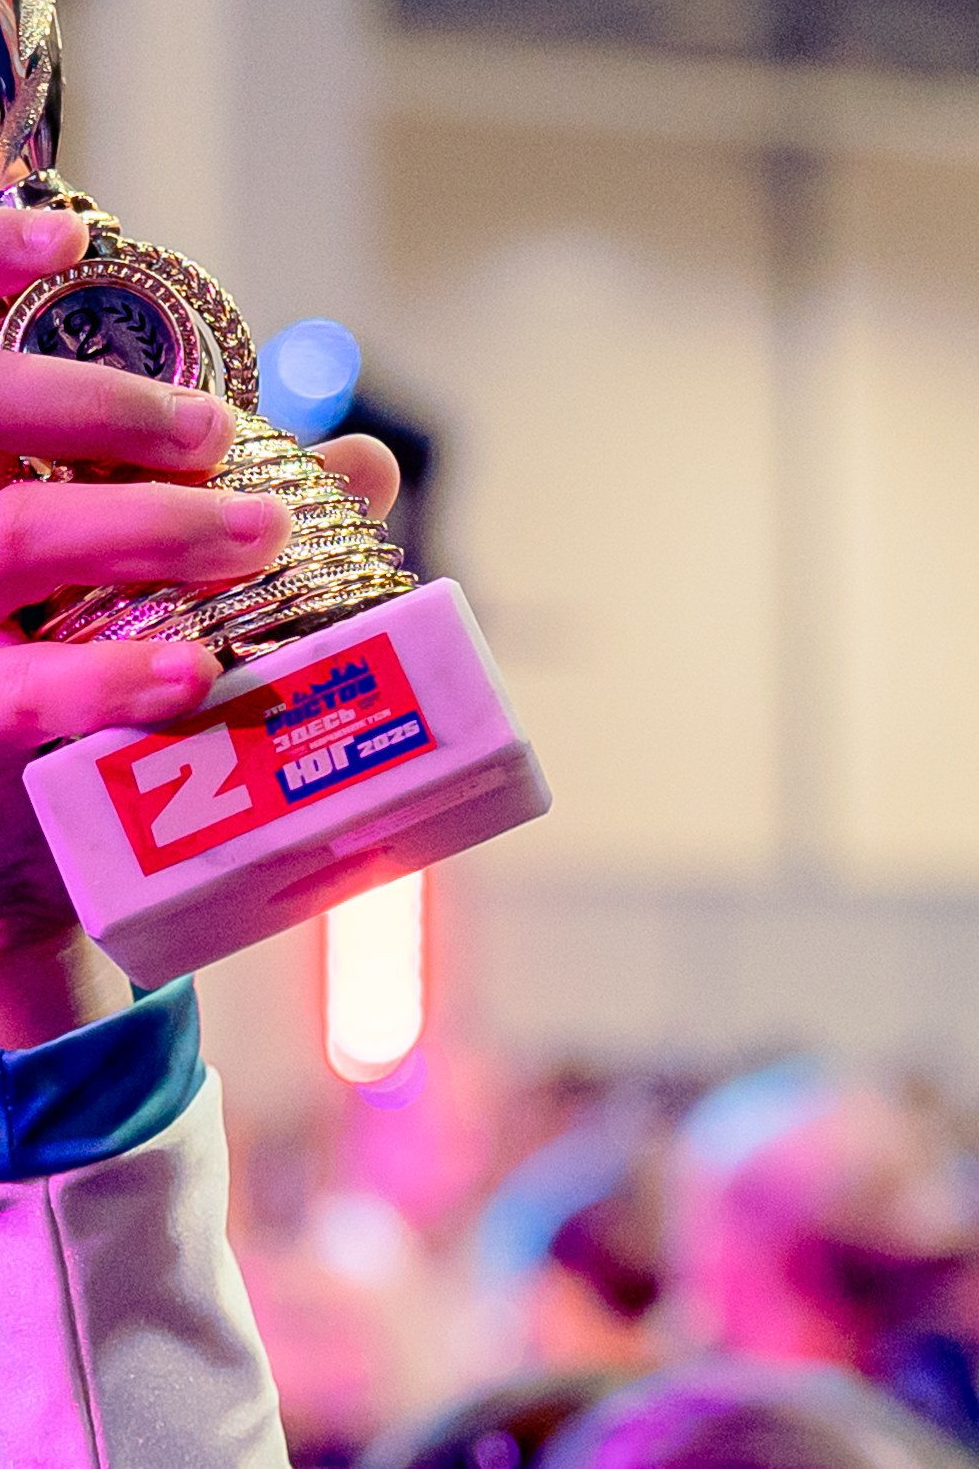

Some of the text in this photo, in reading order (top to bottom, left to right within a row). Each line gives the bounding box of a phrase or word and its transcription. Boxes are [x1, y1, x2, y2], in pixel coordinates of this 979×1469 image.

[63, 308, 111, 361] 2
[273, 708, 356, 753] ЗДЕСЬ
[282, 719, 420, 791] ЮГ 2025
[131, 722, 253, 848] 2
